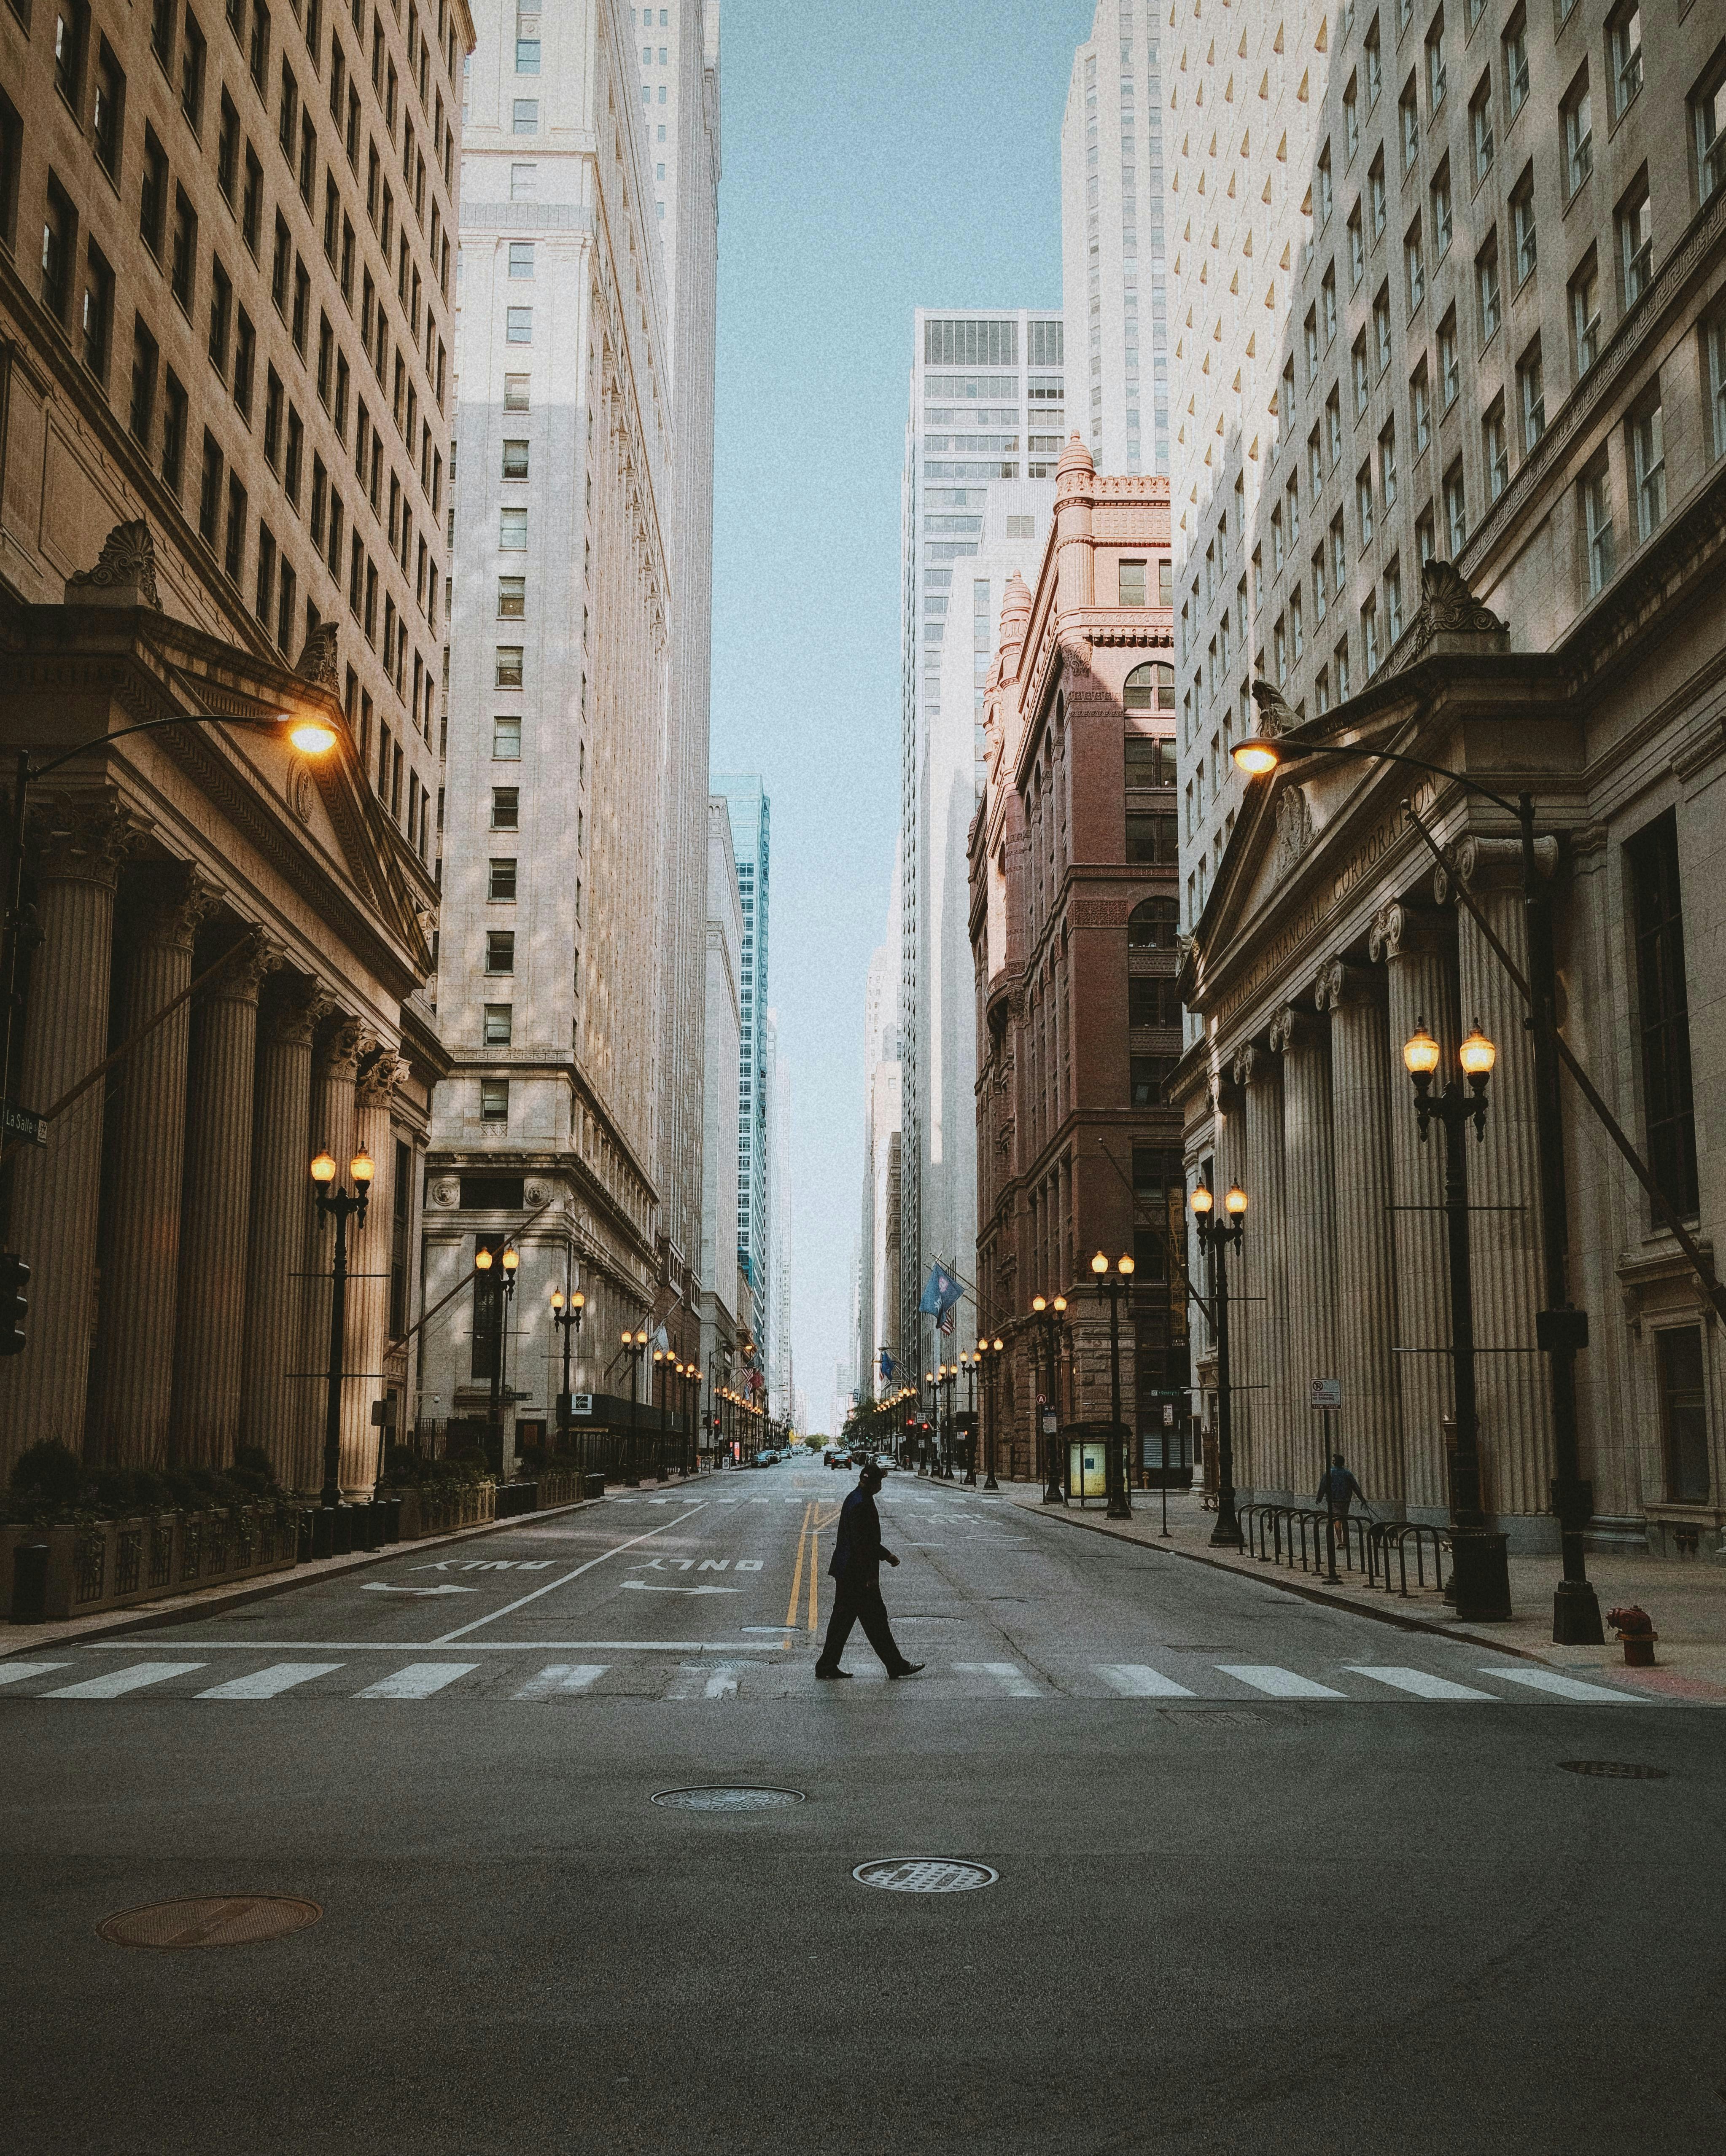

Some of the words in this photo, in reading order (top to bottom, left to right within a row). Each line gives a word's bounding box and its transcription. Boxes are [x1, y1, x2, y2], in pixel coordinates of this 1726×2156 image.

[1216, 964, 1258, 1026] WINTRUST
[1266, 896, 1324, 976] FINANCIAL
[6, 1110, 14, 1126] La
[16, 1114, 32, 1133] Salle
[406, 1559, 559, 1571] ONLY
[626, 1559, 764, 1571] ONLY
